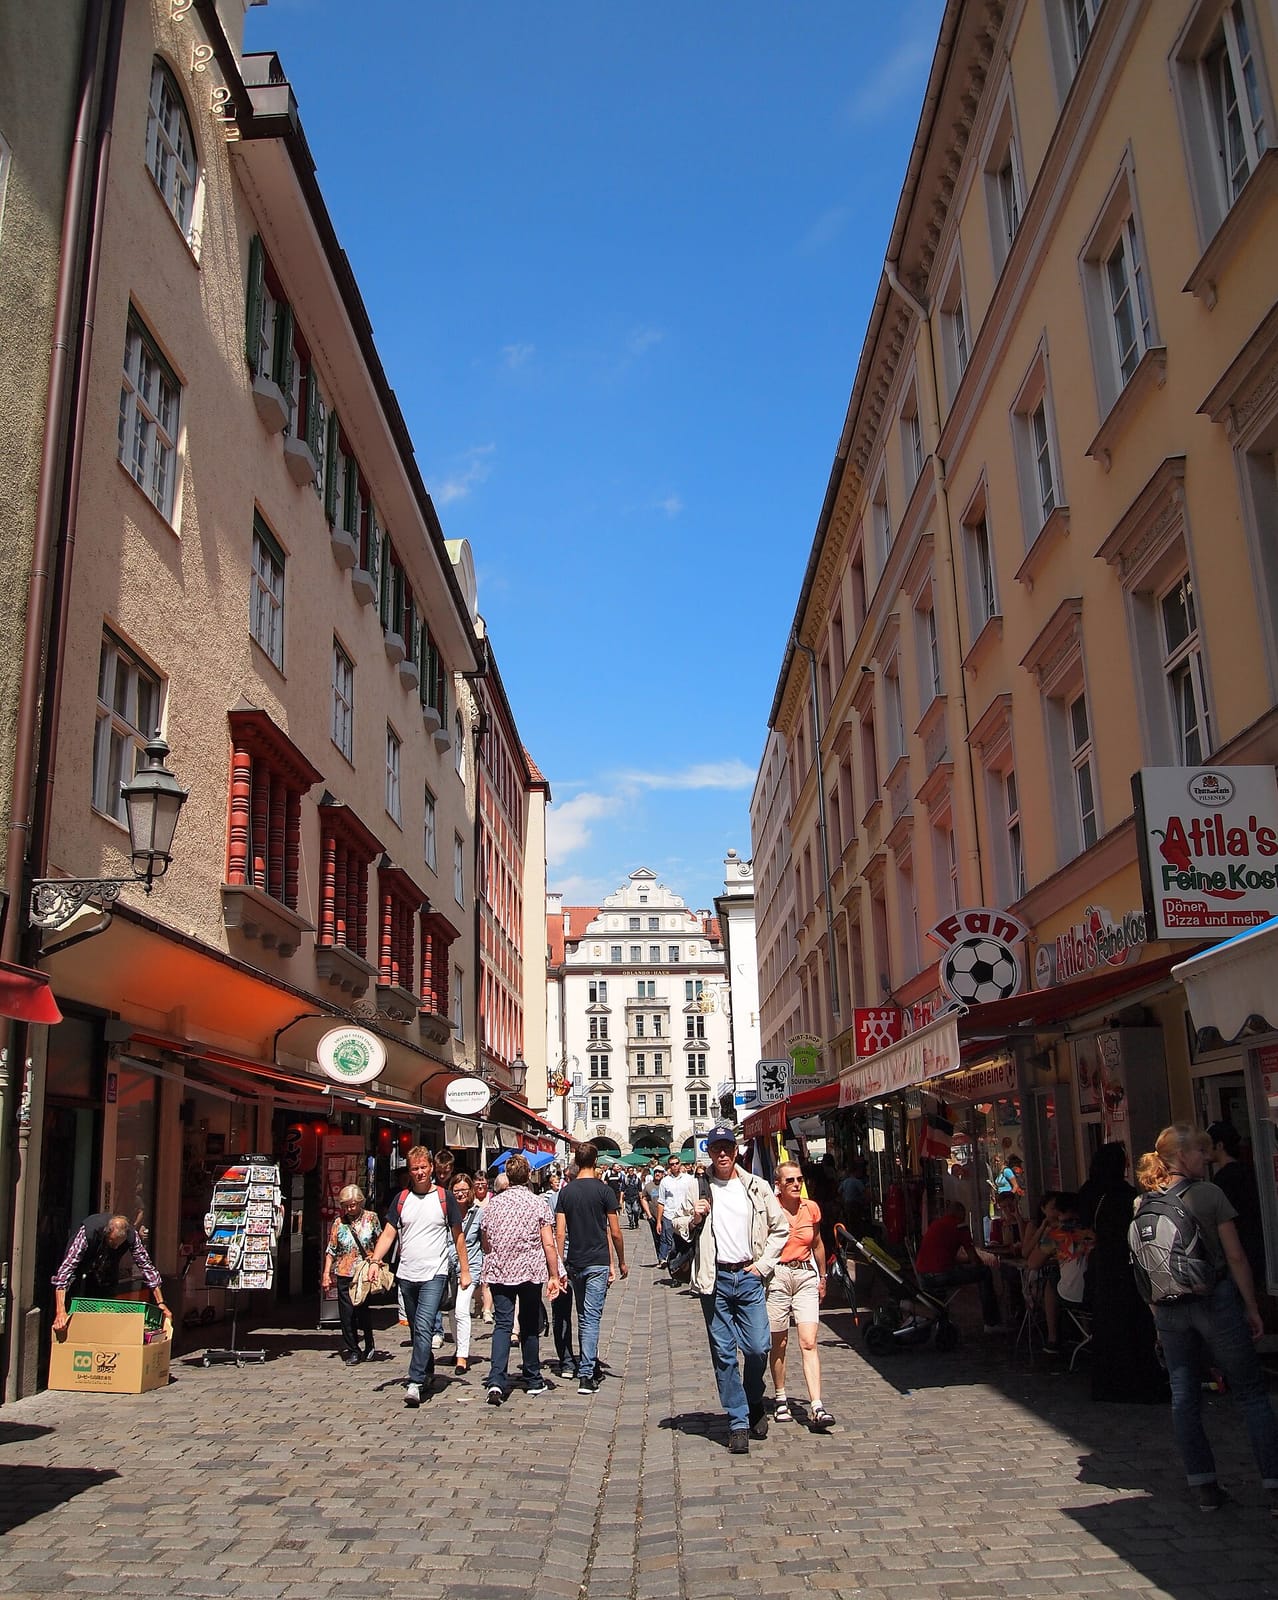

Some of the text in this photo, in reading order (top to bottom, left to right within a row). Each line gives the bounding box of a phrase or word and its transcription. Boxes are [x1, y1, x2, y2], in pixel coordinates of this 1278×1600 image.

[1165, 814, 1278, 857] Atila's
[1162, 864, 1227, 891] Feine
[1166, 901, 1206, 913] Döner,
[935, 913, 1020, 945] Fan
[1167, 915, 1200, 926] Pizza
[1204, 914, 1228, 925] und
[1056, 924, 1097, 984] Atila's
[1123, 912, 1146, 948] Kos
[766, 1092, 785, 1100] 1860
[95, 1352, 117, 1367] CZ
